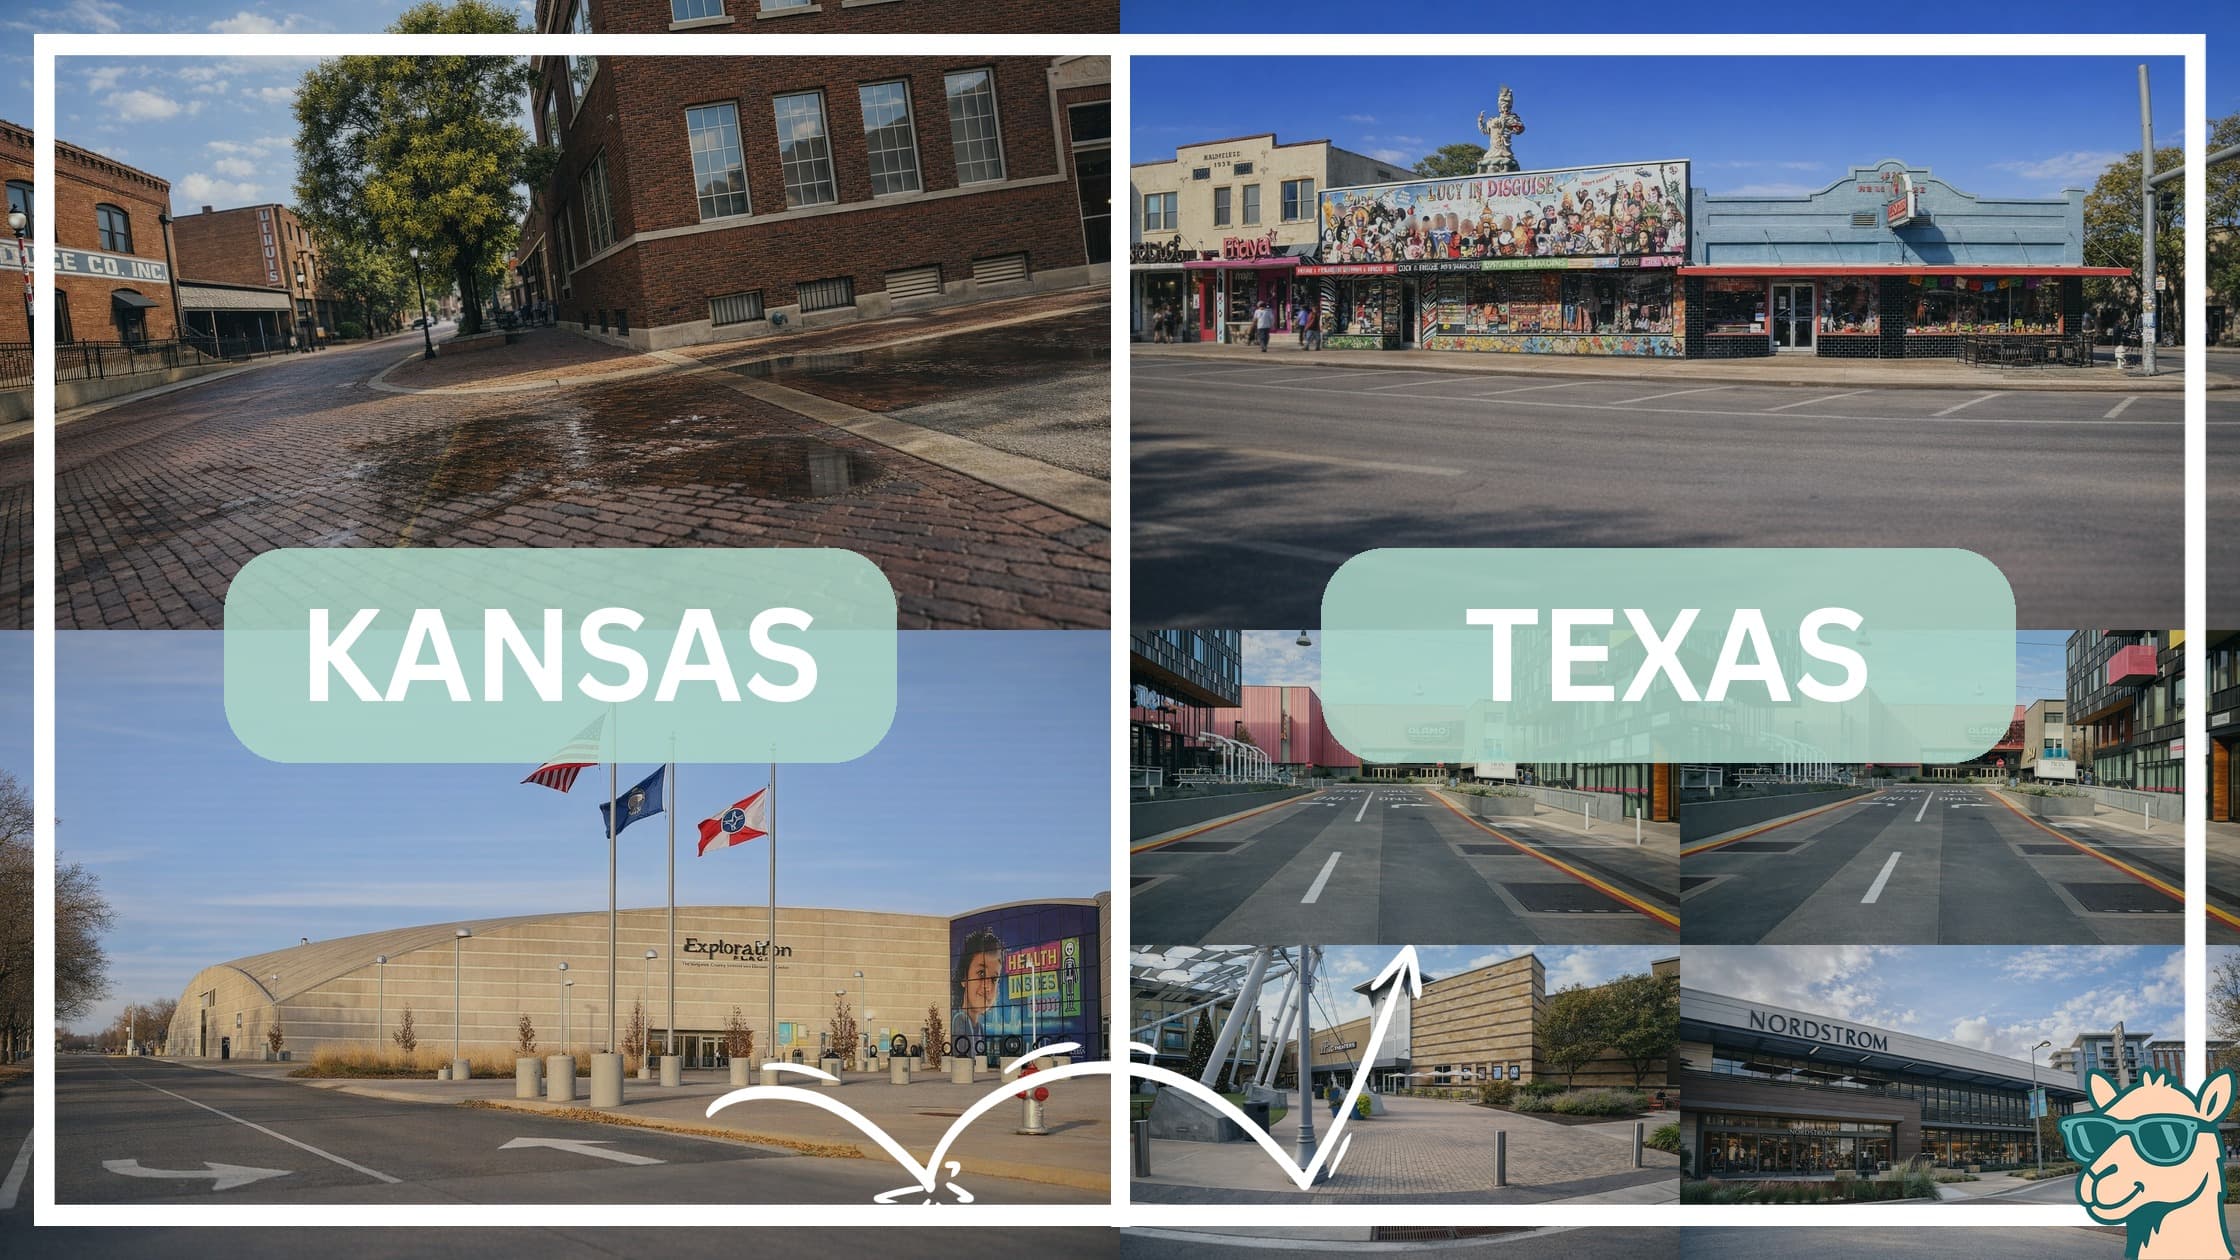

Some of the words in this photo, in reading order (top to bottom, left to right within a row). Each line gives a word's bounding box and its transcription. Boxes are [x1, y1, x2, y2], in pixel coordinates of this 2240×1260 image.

[1427, 183, 1464, 201] LUCY
[1469, 181, 1482, 200] IN
[1487, 176, 1554, 198] DISGUISE
[87, 255, 125, 276] CO.
[131, 261, 166, 280] INC.
[1008, 949, 1057, 970] HEALTH
[1750, 1009, 1888, 1051] NORDSTROM
